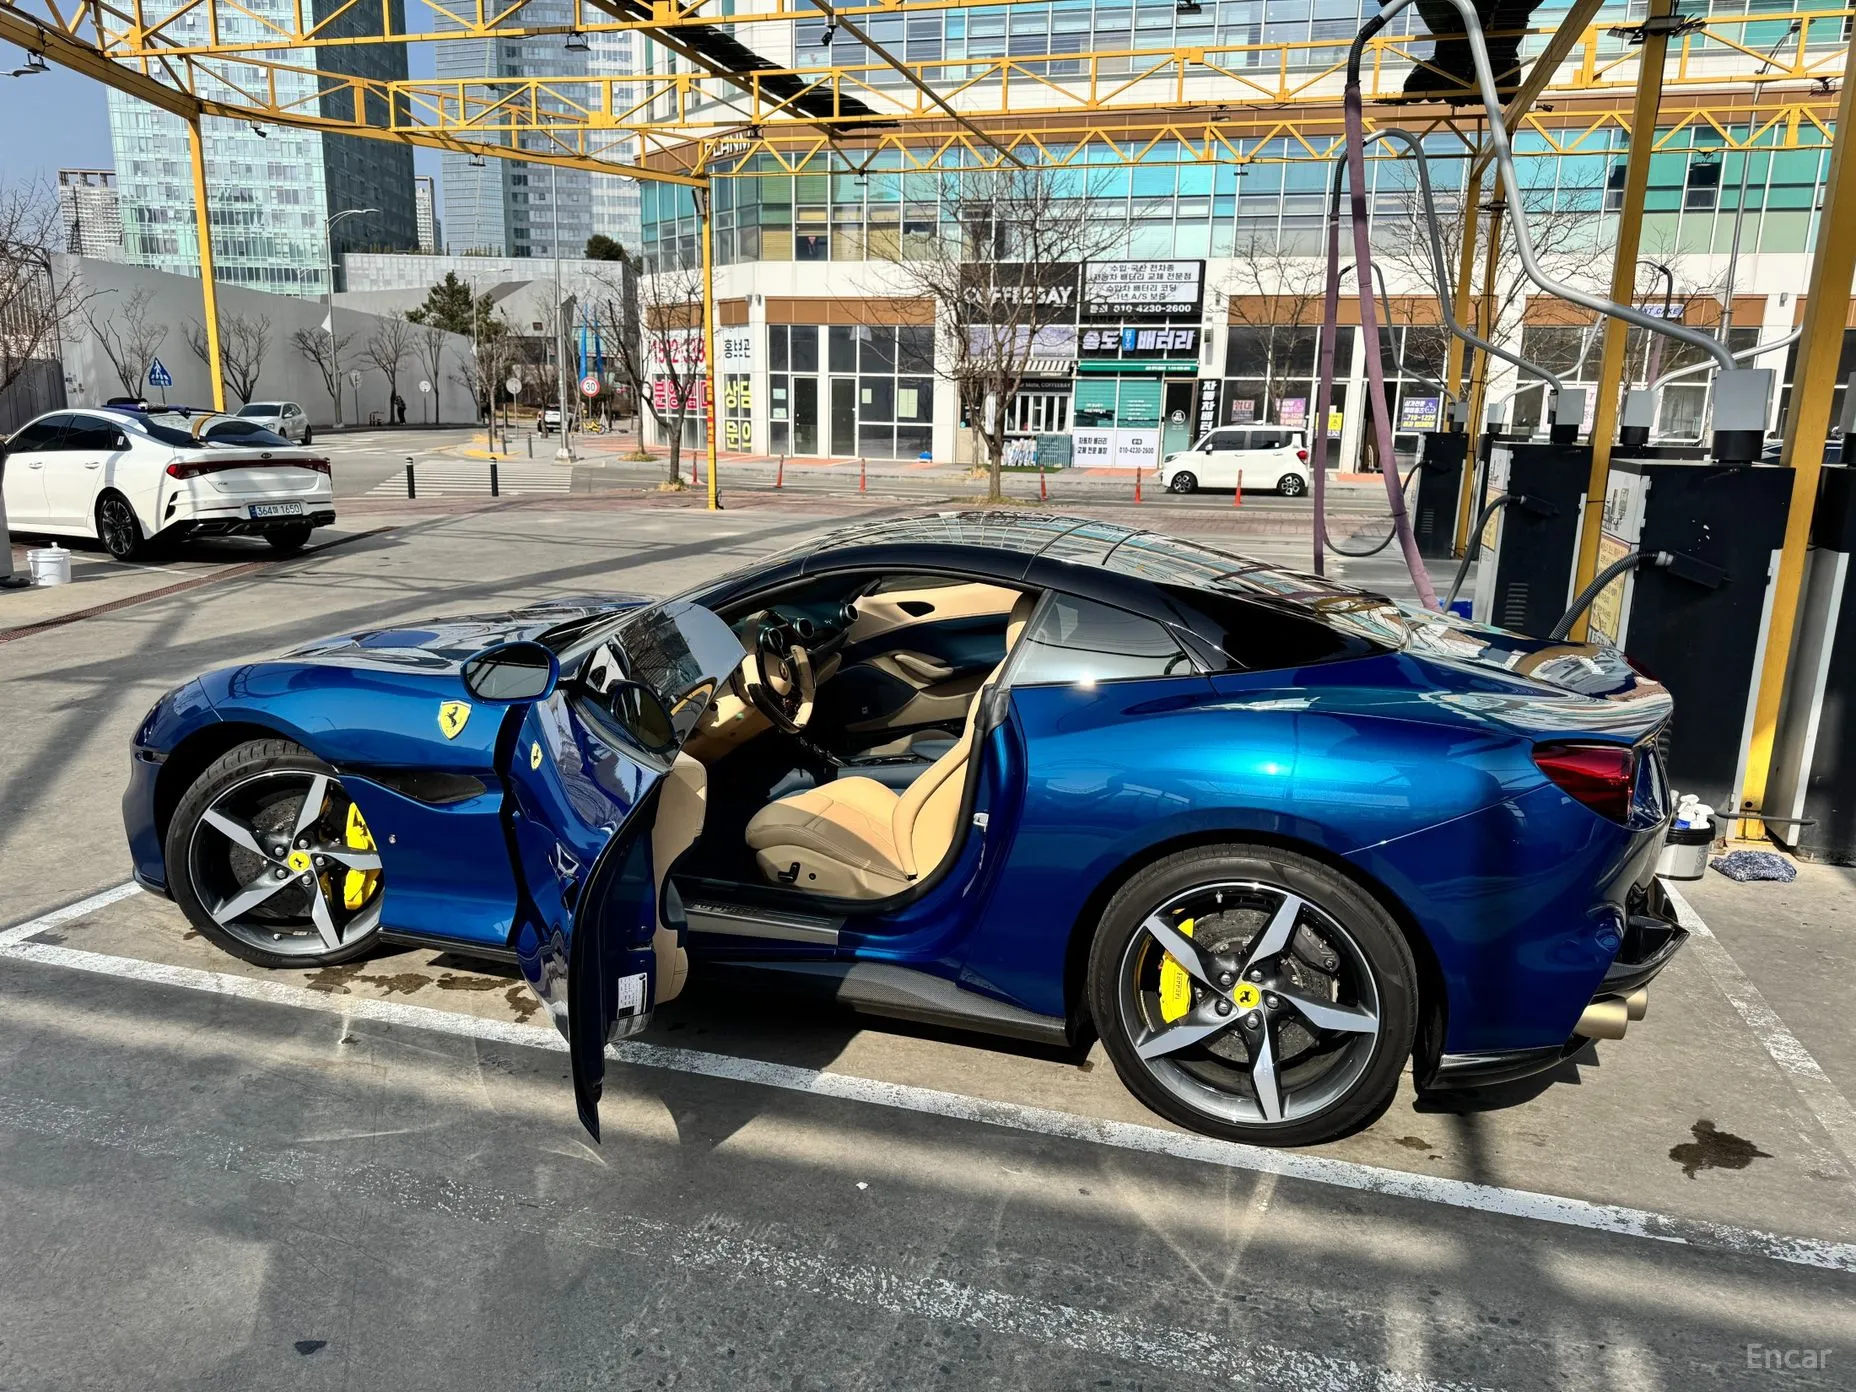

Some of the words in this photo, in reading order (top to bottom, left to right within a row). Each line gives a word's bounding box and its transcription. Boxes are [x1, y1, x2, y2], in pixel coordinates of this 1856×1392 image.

[1121, 272, 1144, 280] 배터리
[1167, 272, 1191, 280] 전문점
[1082, 330, 1119, 350] 송도
[1136, 330, 1195, 350] 배터리
[585, 381, 595, 391] 30
[725, 380, 752, 409] 상담
[726, 421, 752, 449] 문의
[280, 504, 299, 513] 1650
